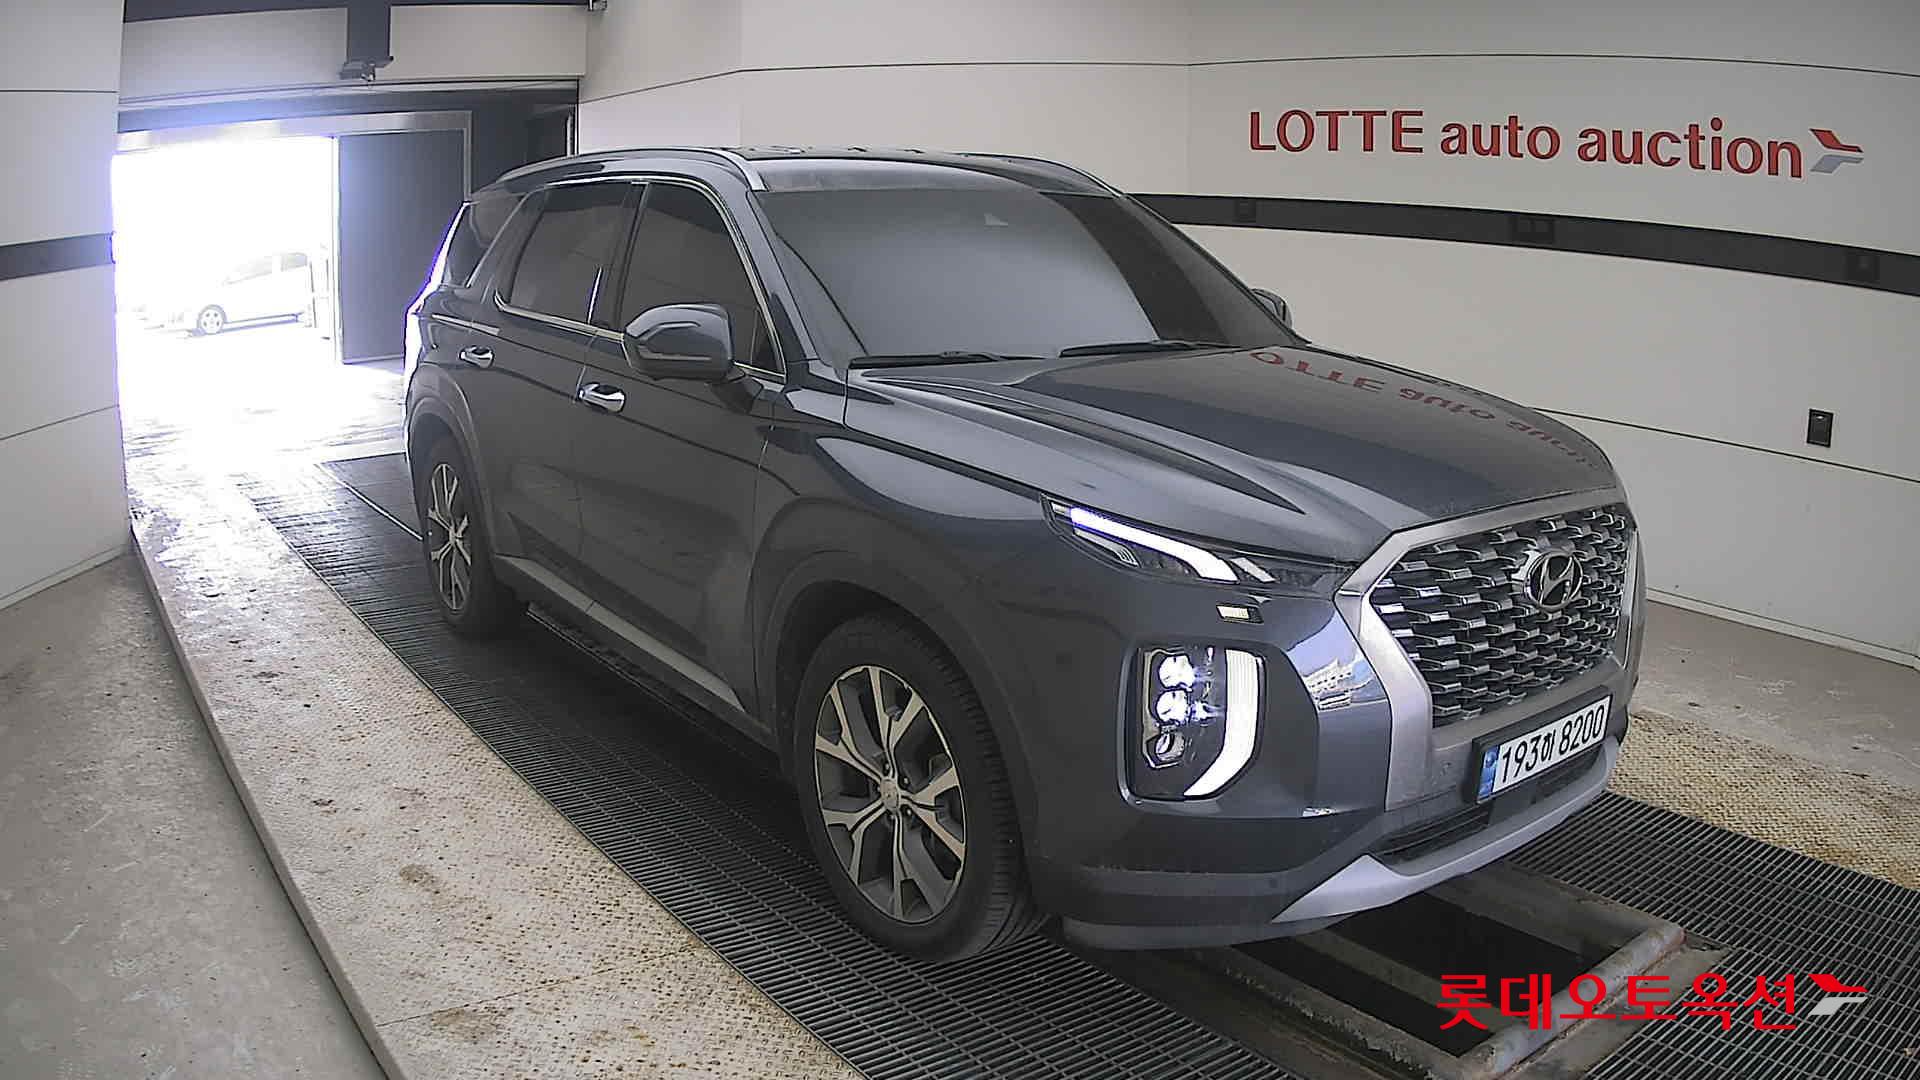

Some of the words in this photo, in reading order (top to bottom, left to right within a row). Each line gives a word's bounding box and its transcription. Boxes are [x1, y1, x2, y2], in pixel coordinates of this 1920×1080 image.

[1249, 109, 1425, 154] LOTTE
[1440, 115, 1561, 160] auto
[1577, 116, 1803, 179] auction
[1559, 705, 1605, 755] 8200
